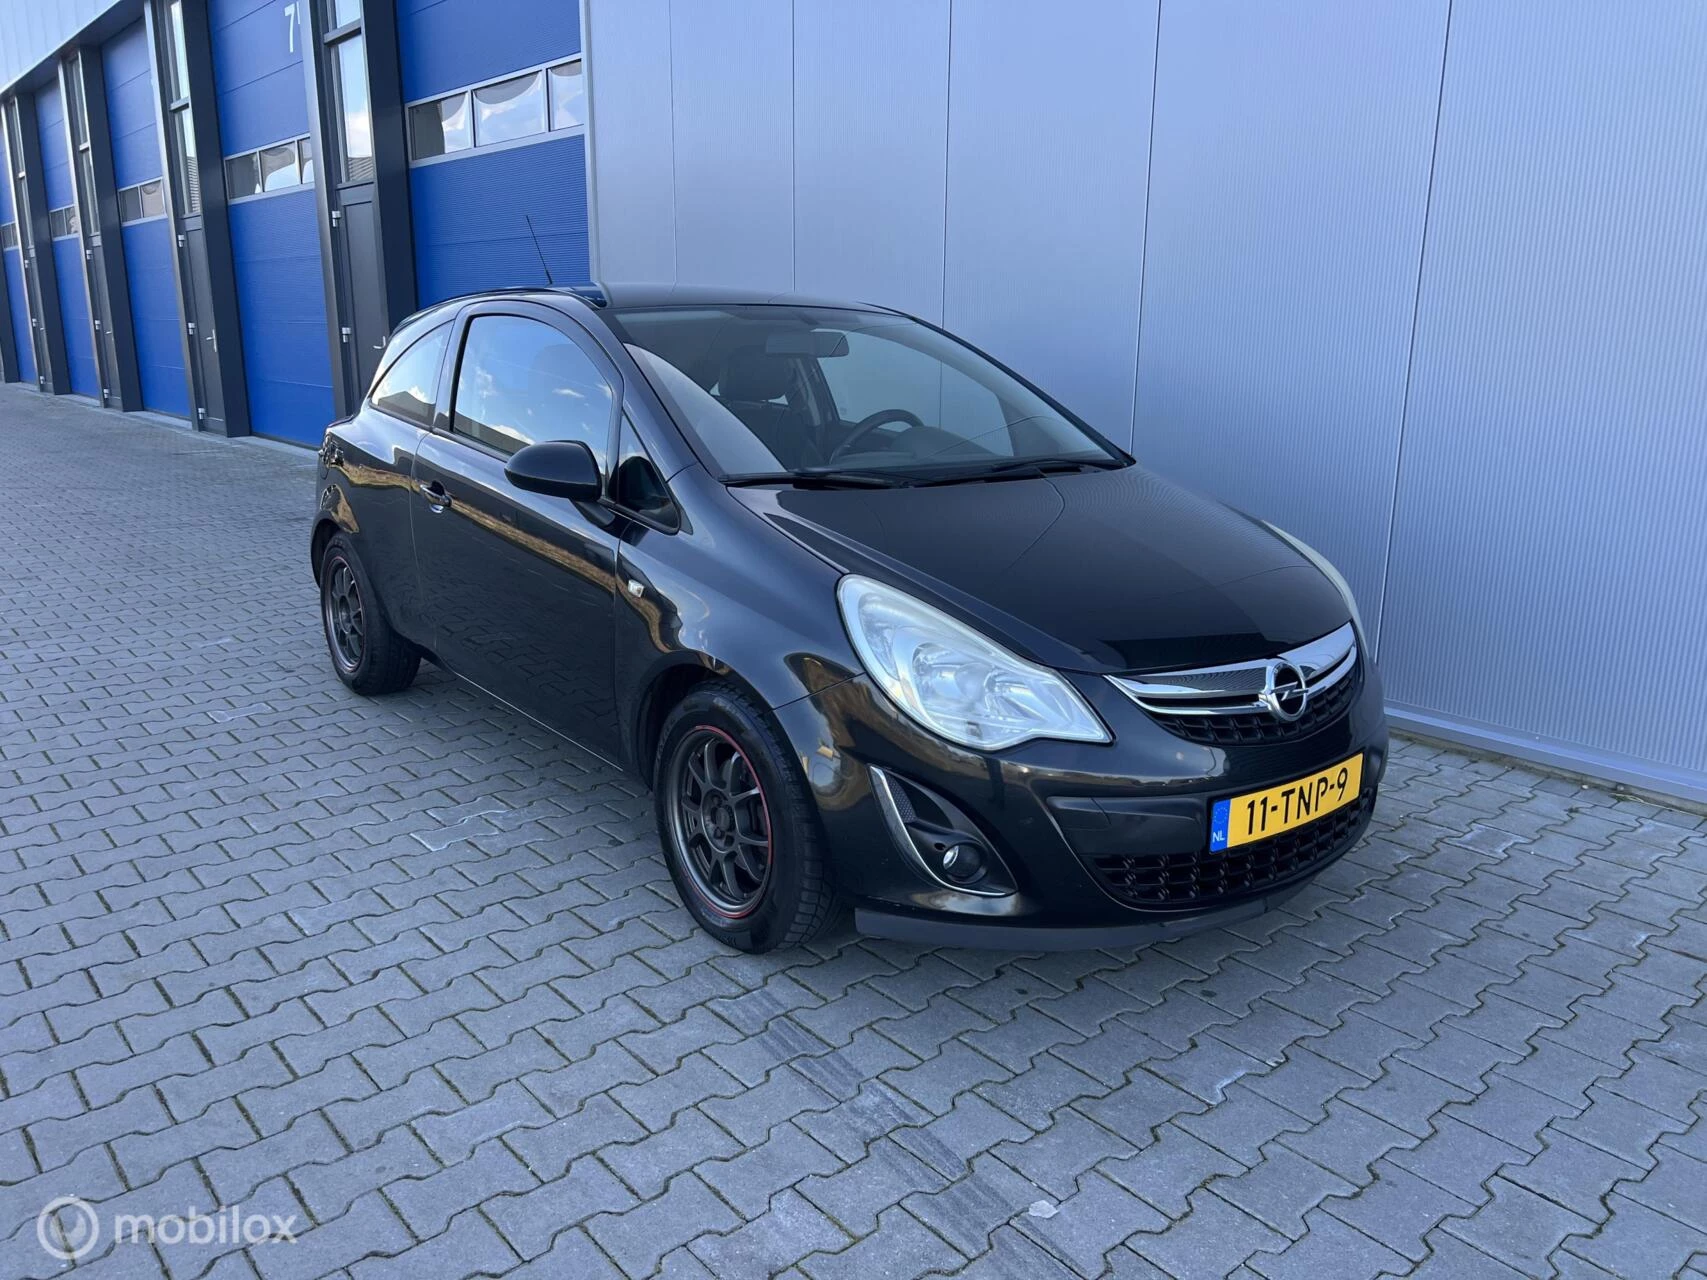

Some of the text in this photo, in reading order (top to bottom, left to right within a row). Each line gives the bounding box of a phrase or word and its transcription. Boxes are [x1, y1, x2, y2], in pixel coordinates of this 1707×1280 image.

[284, 1, 300, 53] 7
[1247, 767, 1348, 835] 11-TNP-9
[1212, 830, 1225, 843] NL
